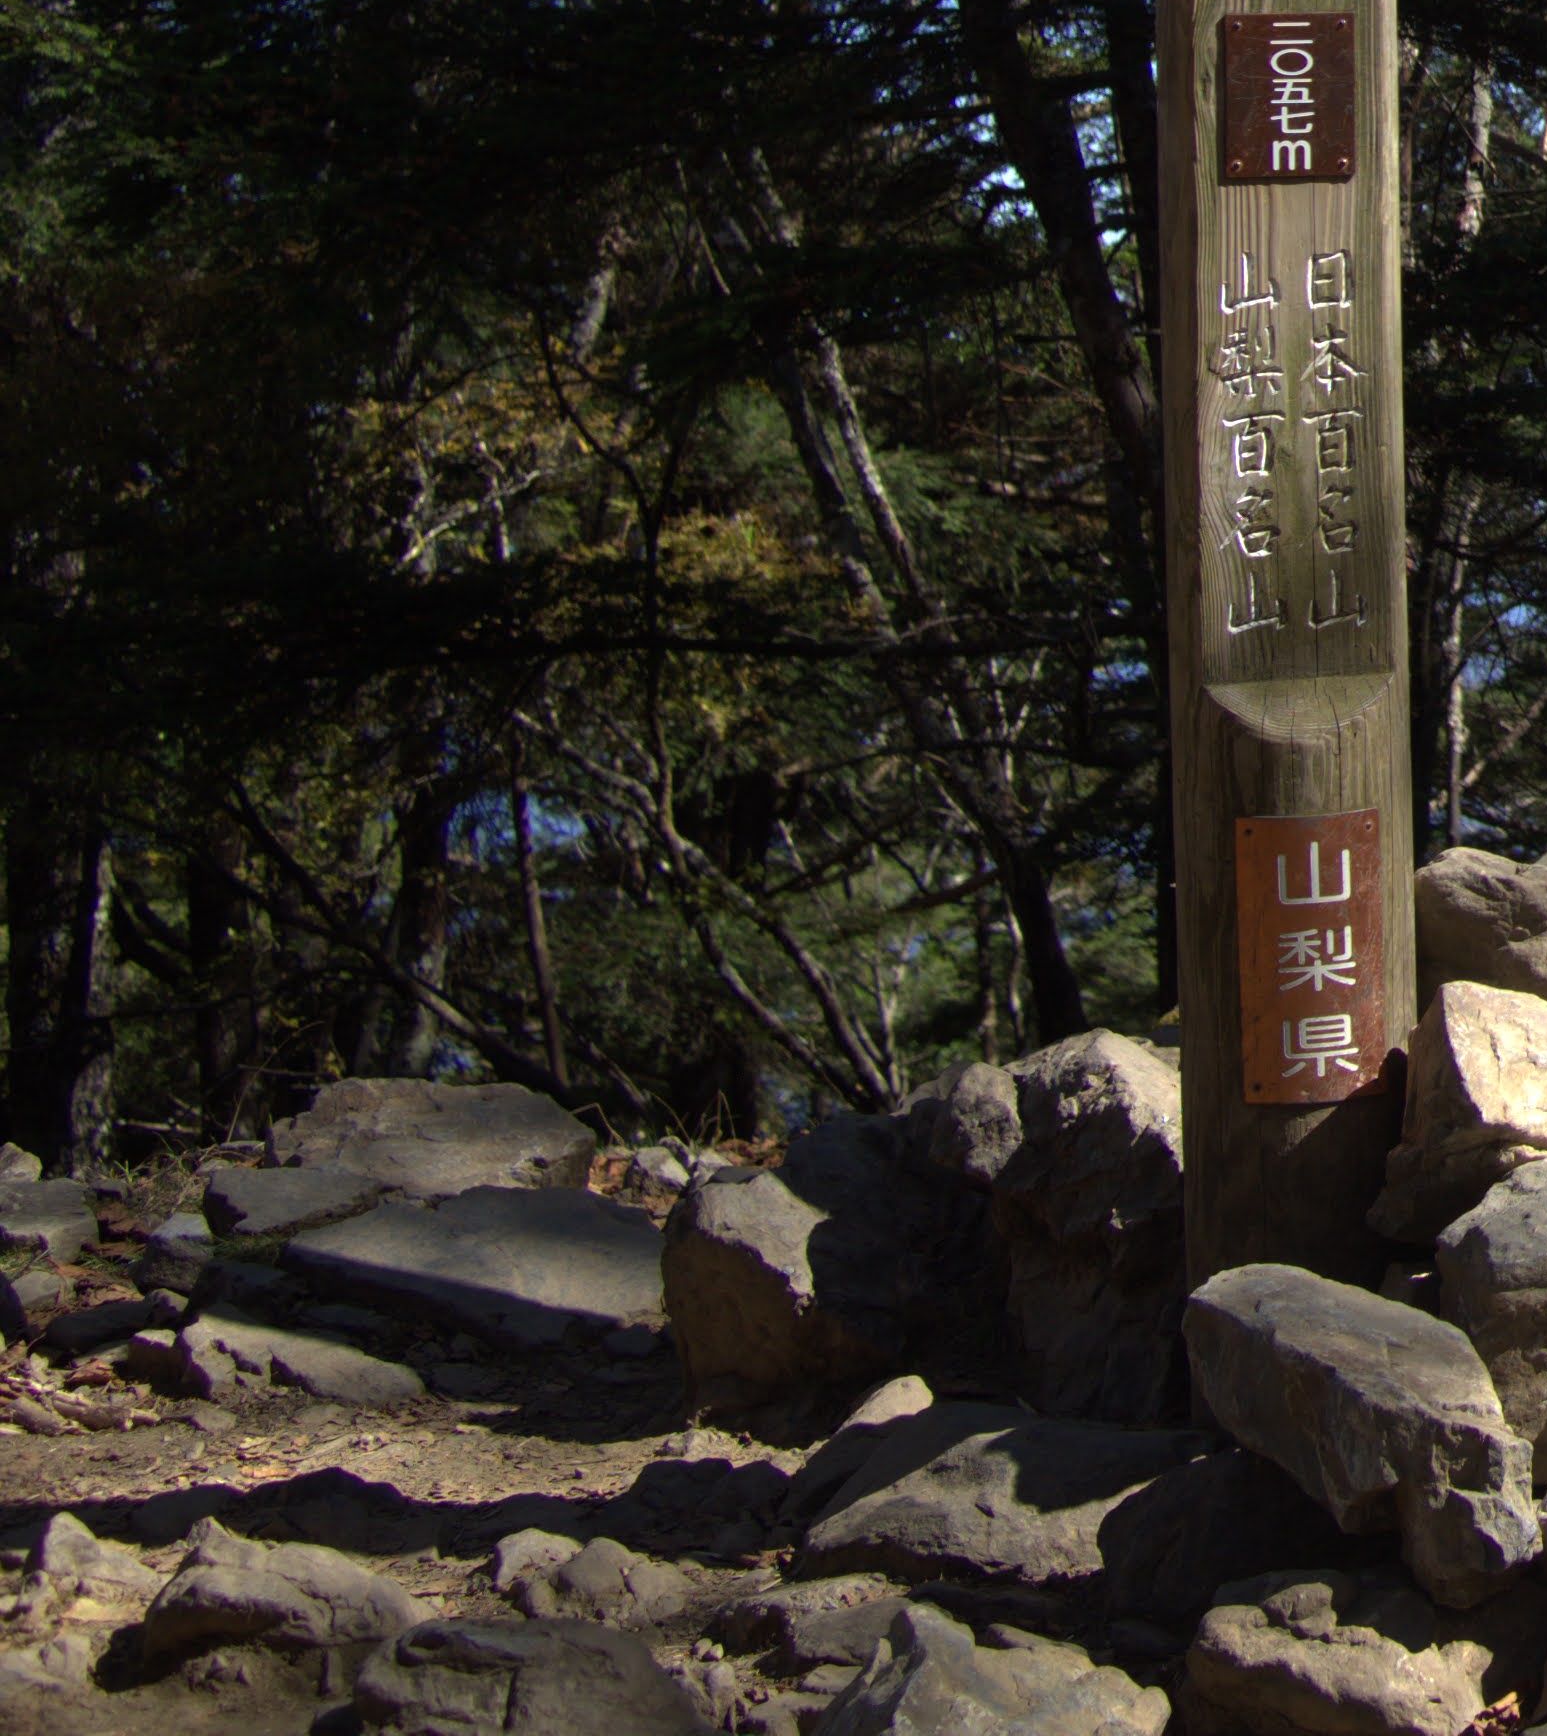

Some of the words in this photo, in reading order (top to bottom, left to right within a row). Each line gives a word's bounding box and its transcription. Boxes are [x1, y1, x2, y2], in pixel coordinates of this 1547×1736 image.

[1217, 249, 1287, 636] 山梨百名山
[1299, 249, 1370, 632] 日本百名山
[1277, 840, 1360, 1079] 山梨県
